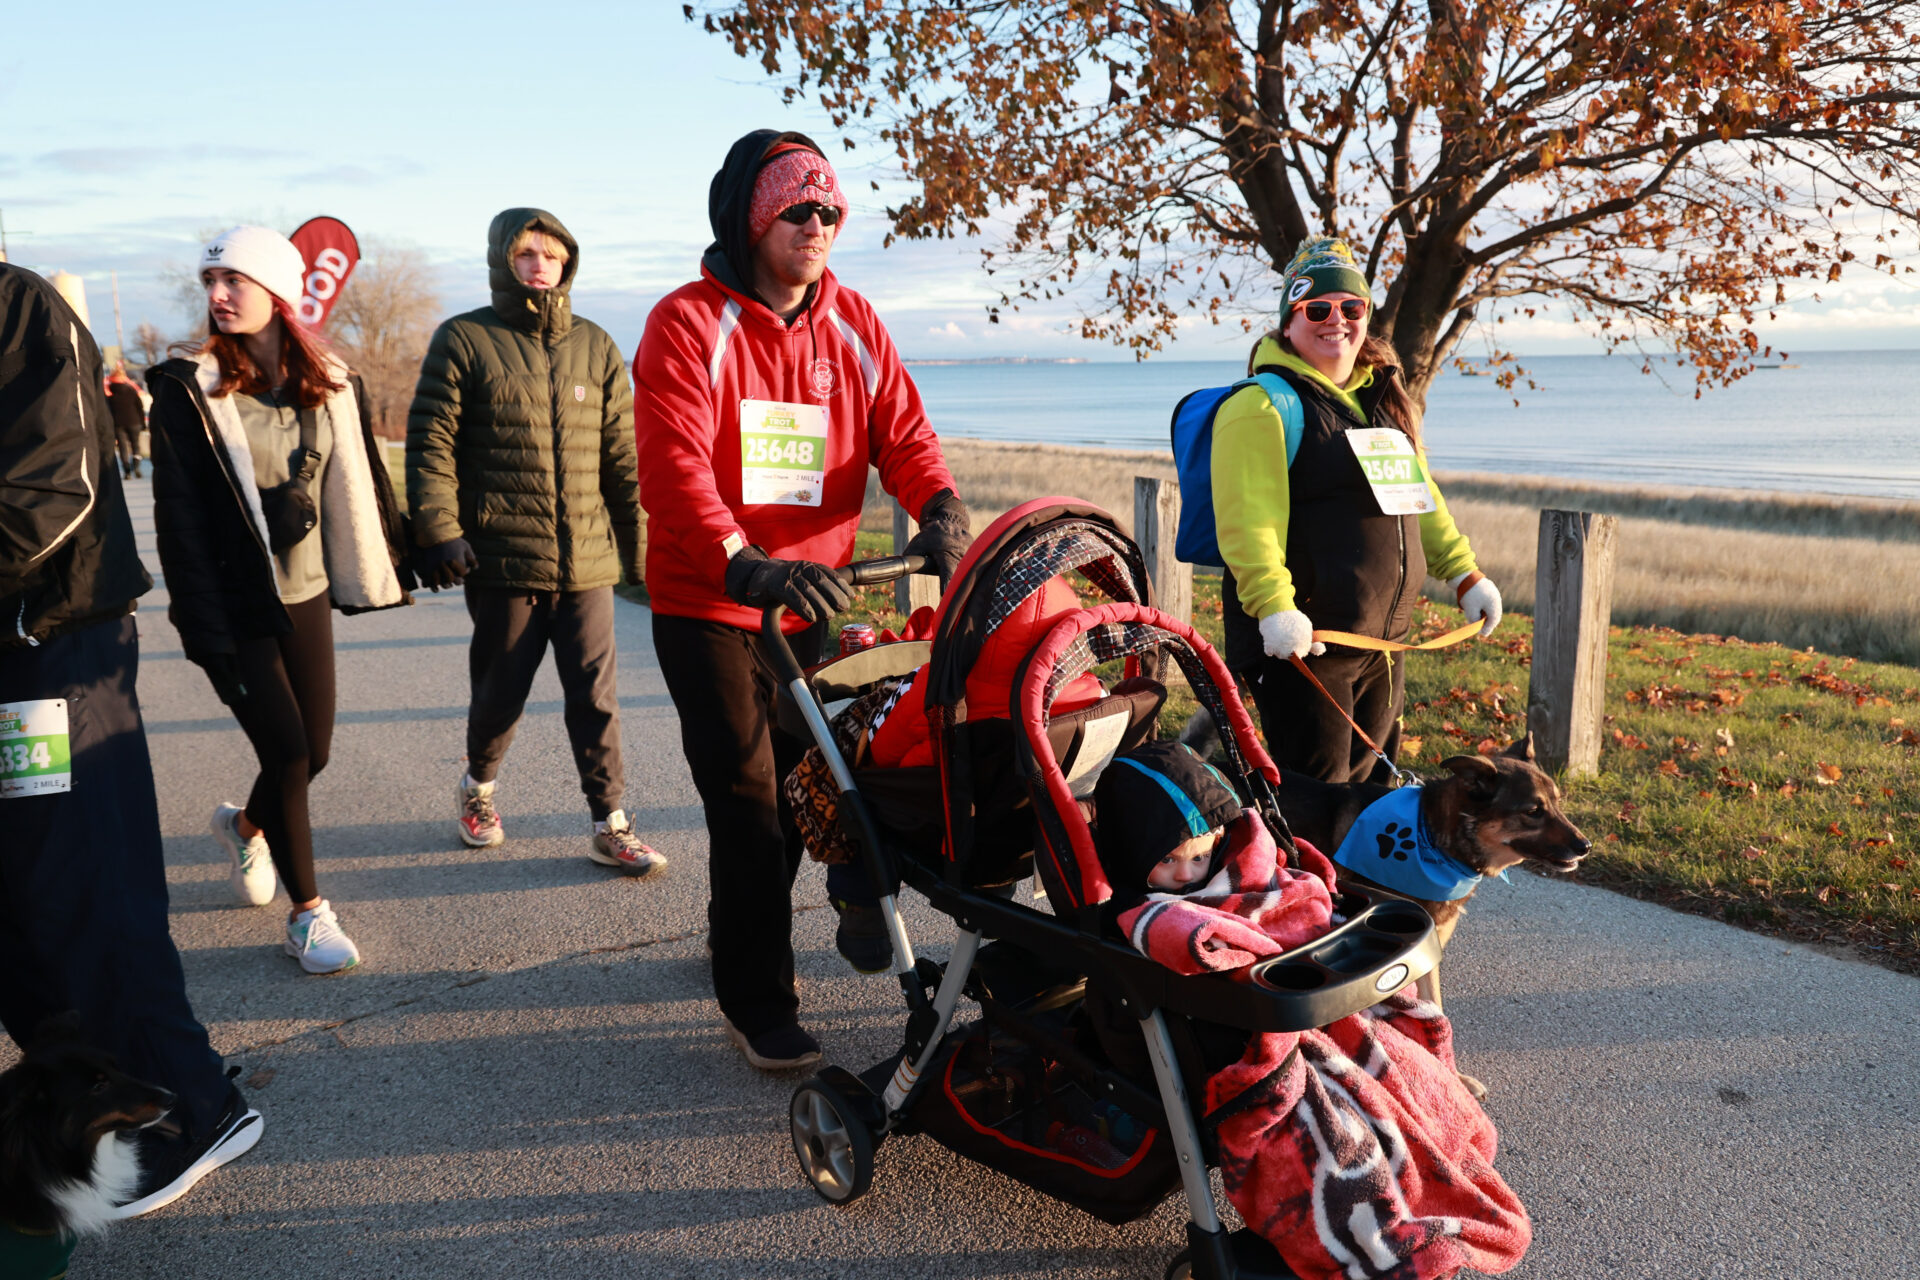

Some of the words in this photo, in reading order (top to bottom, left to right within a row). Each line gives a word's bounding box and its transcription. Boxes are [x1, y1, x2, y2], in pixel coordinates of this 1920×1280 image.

[769, 418, 792, 427] TROT
[746, 437, 815, 466] 25648
[1363, 459, 1412, 481] 25647
[40, 780, 60, 788] MILE
